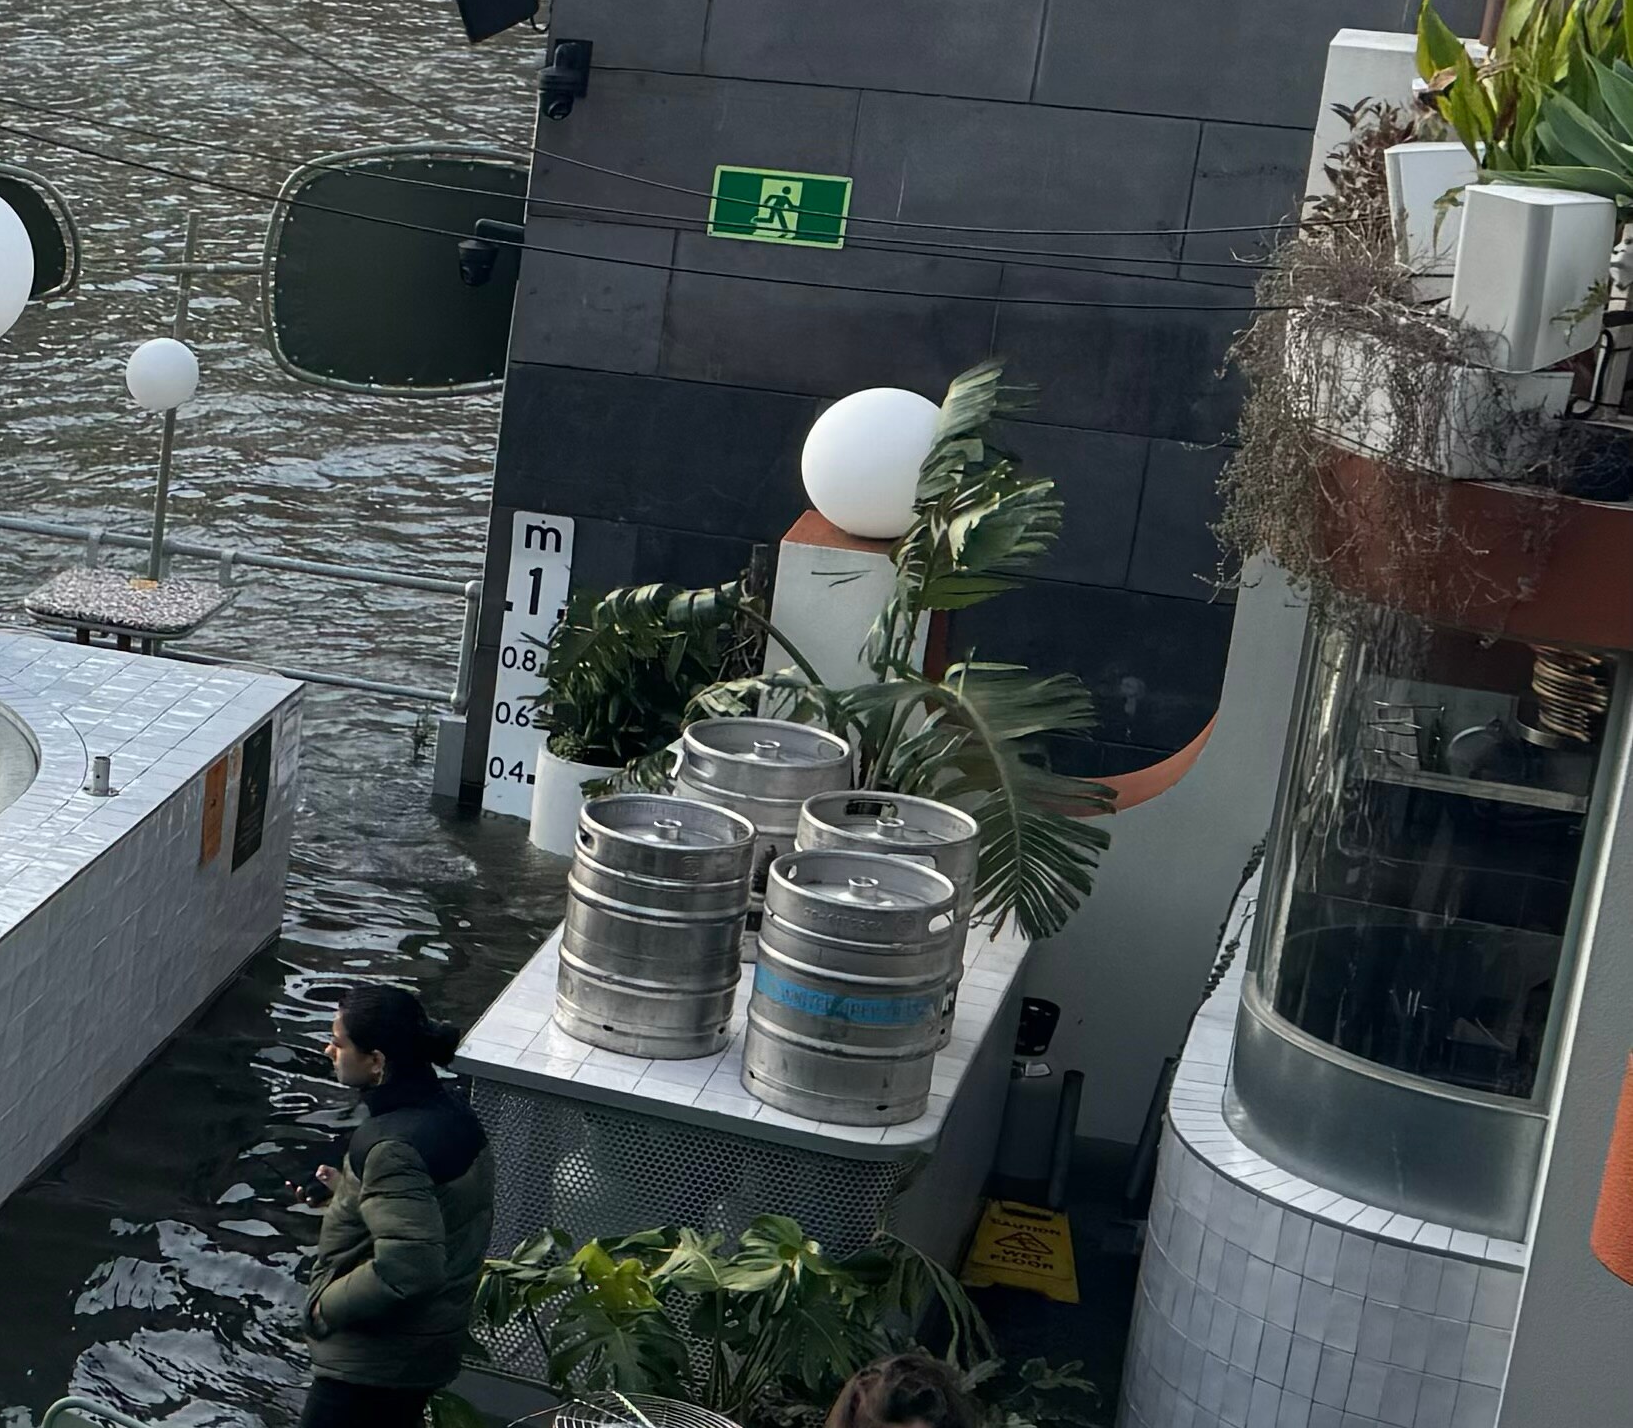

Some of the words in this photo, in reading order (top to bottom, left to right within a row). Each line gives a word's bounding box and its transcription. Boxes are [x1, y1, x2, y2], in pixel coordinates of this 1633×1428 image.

[524, 523, 562, 553] m
[528, 567, 543, 616] 1
[501, 645, 537, 672] 0.8
[495, 701, 531, 728] 0.6
[488, 756, 524, 783] 0.4
[990, 1217, 1061, 1236] CAUTION
[989, 1253, 1054, 1270] FLOOR
[1002, 1249, 1041, 1261] WET
